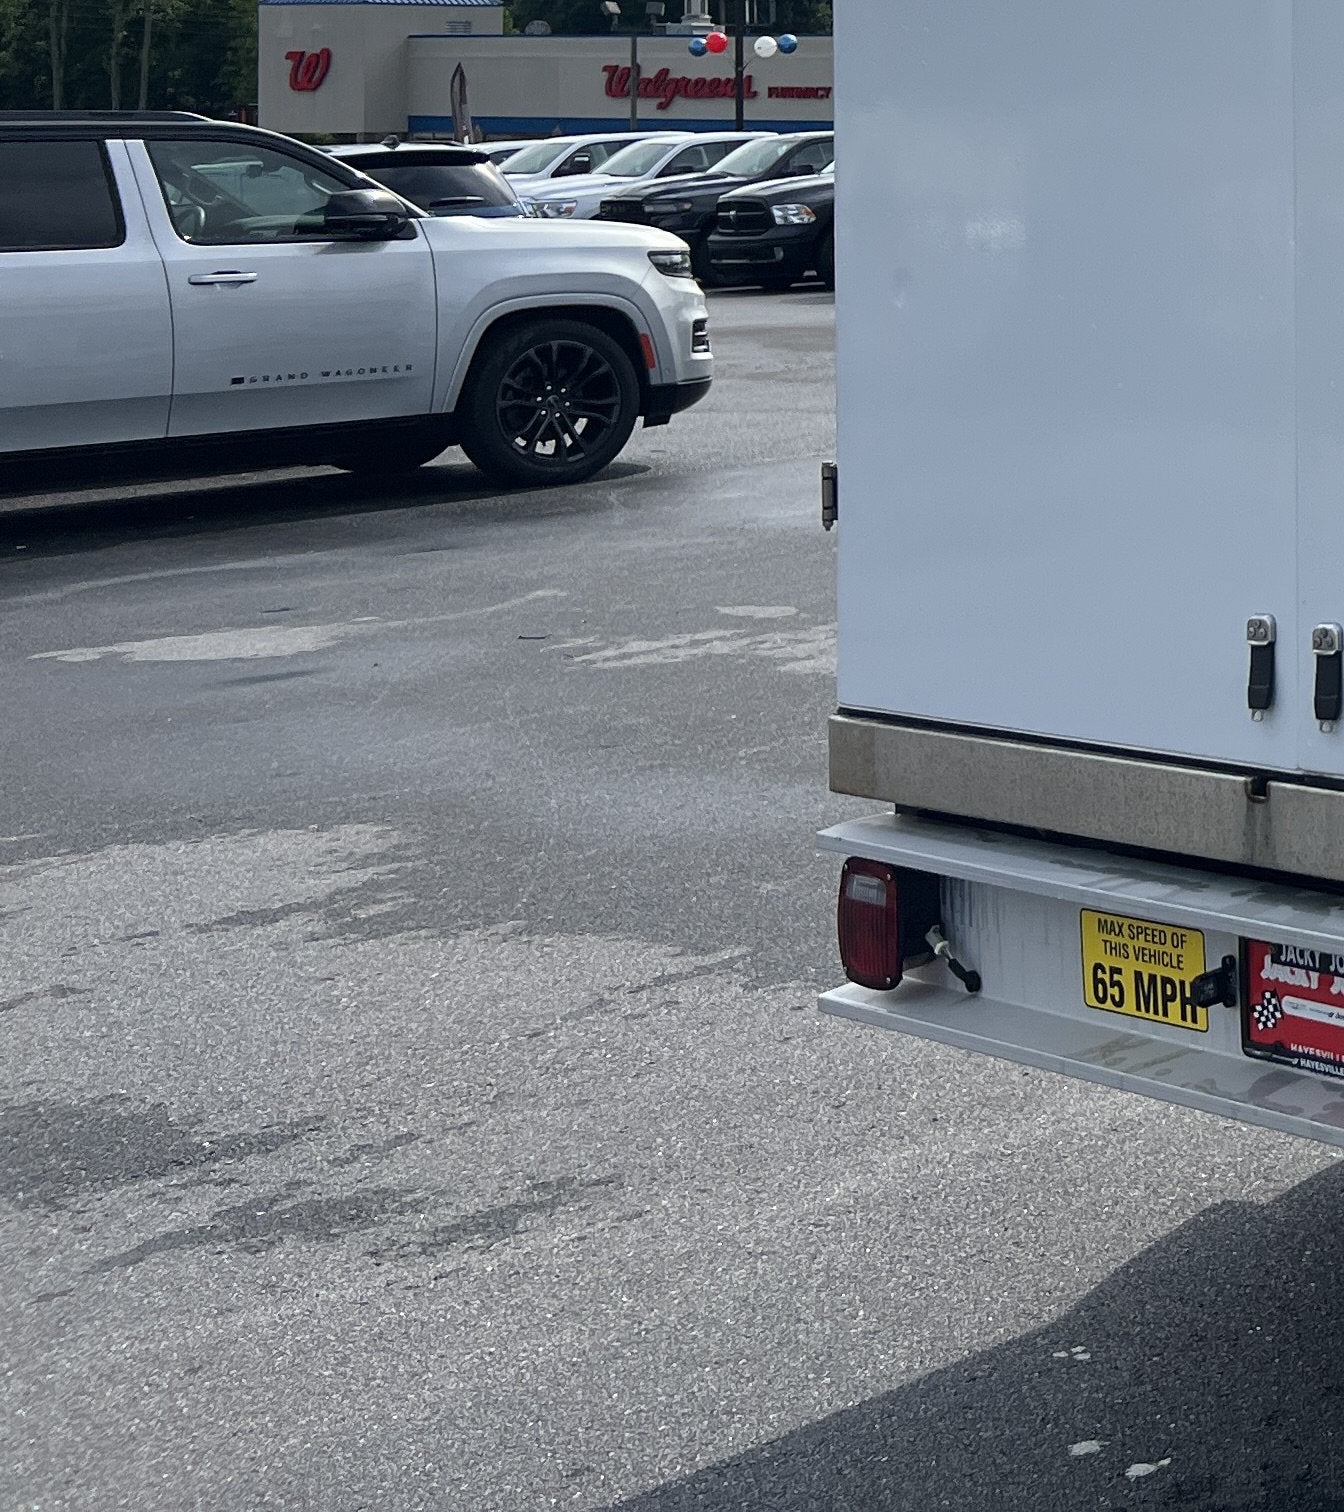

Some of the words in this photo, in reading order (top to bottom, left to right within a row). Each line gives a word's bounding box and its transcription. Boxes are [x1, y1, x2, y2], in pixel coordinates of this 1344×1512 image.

[285, 47, 332, 91] W
[250, 372, 309, 384] GRAND
[321, 364, 413, 378] WAGONEER
[1097, 917, 1125, 938] MAX
[1127, 923, 1167, 946] SPEED
[1171, 932, 1188, 949] OF
[1102, 939, 1129, 959] THIS
[1132, 945, 1185, 970] VEHICLE
[1280, 944, 1321, 969] JACKY
[1092, 962, 1125, 1008] 65
[1134, 969, 1198, 1024] MPH
